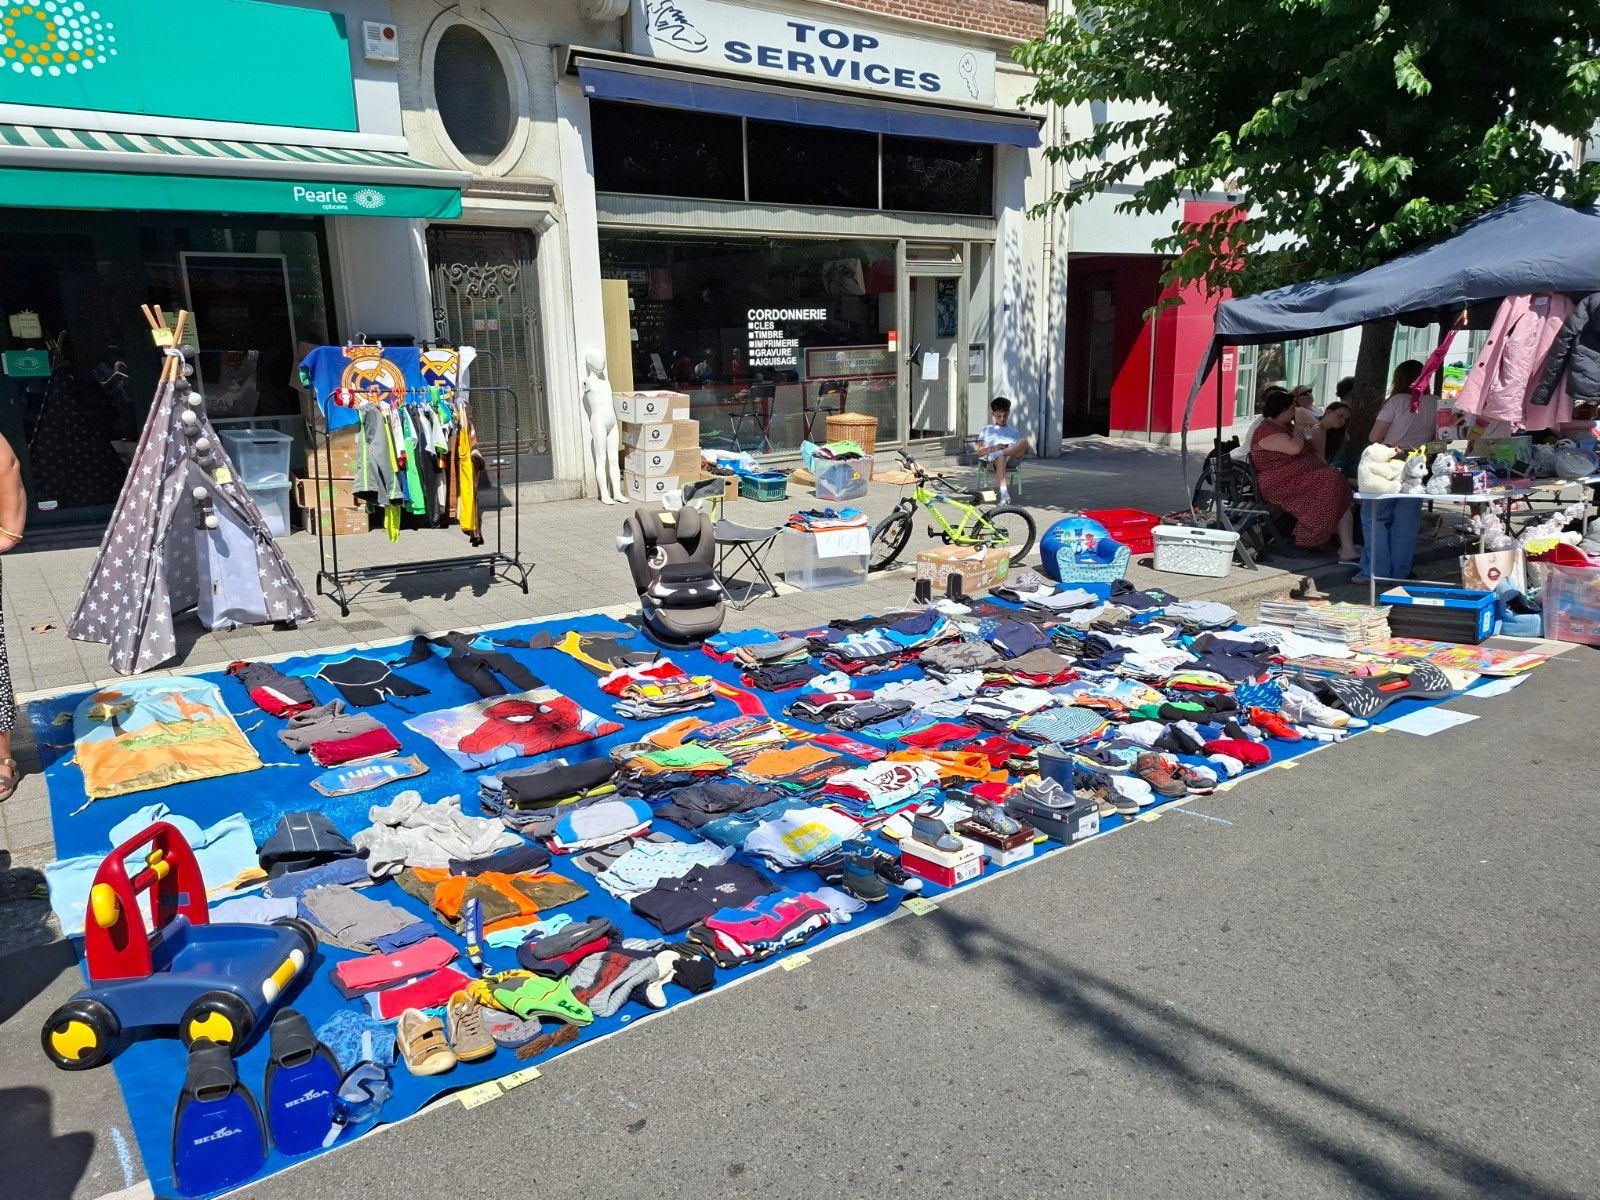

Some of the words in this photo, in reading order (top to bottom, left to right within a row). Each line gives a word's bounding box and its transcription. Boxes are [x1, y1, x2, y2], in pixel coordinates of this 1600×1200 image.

[787, 21, 879, 53] TOP
[724, 40, 942, 93] SERVICES
[293, 186, 348, 203] Pearle
[747, 309, 827, 320] CORDONNERIE
[754, 321, 775, 330] CLES
[754, 330, 784, 339] TIMBRE
[754, 339, 799, 348] IMPRIMERIE
[754, 348, 792, 357] GRAVURE
[755, 357, 797, 366] AIGUISAGE
[346, 765, 384, 778] LIKE
[292, 865, 352, 893] CREATE
[285, 1089, 330, 1109] BELUGA
[193, 1127, 243, 1145] BELUGA
